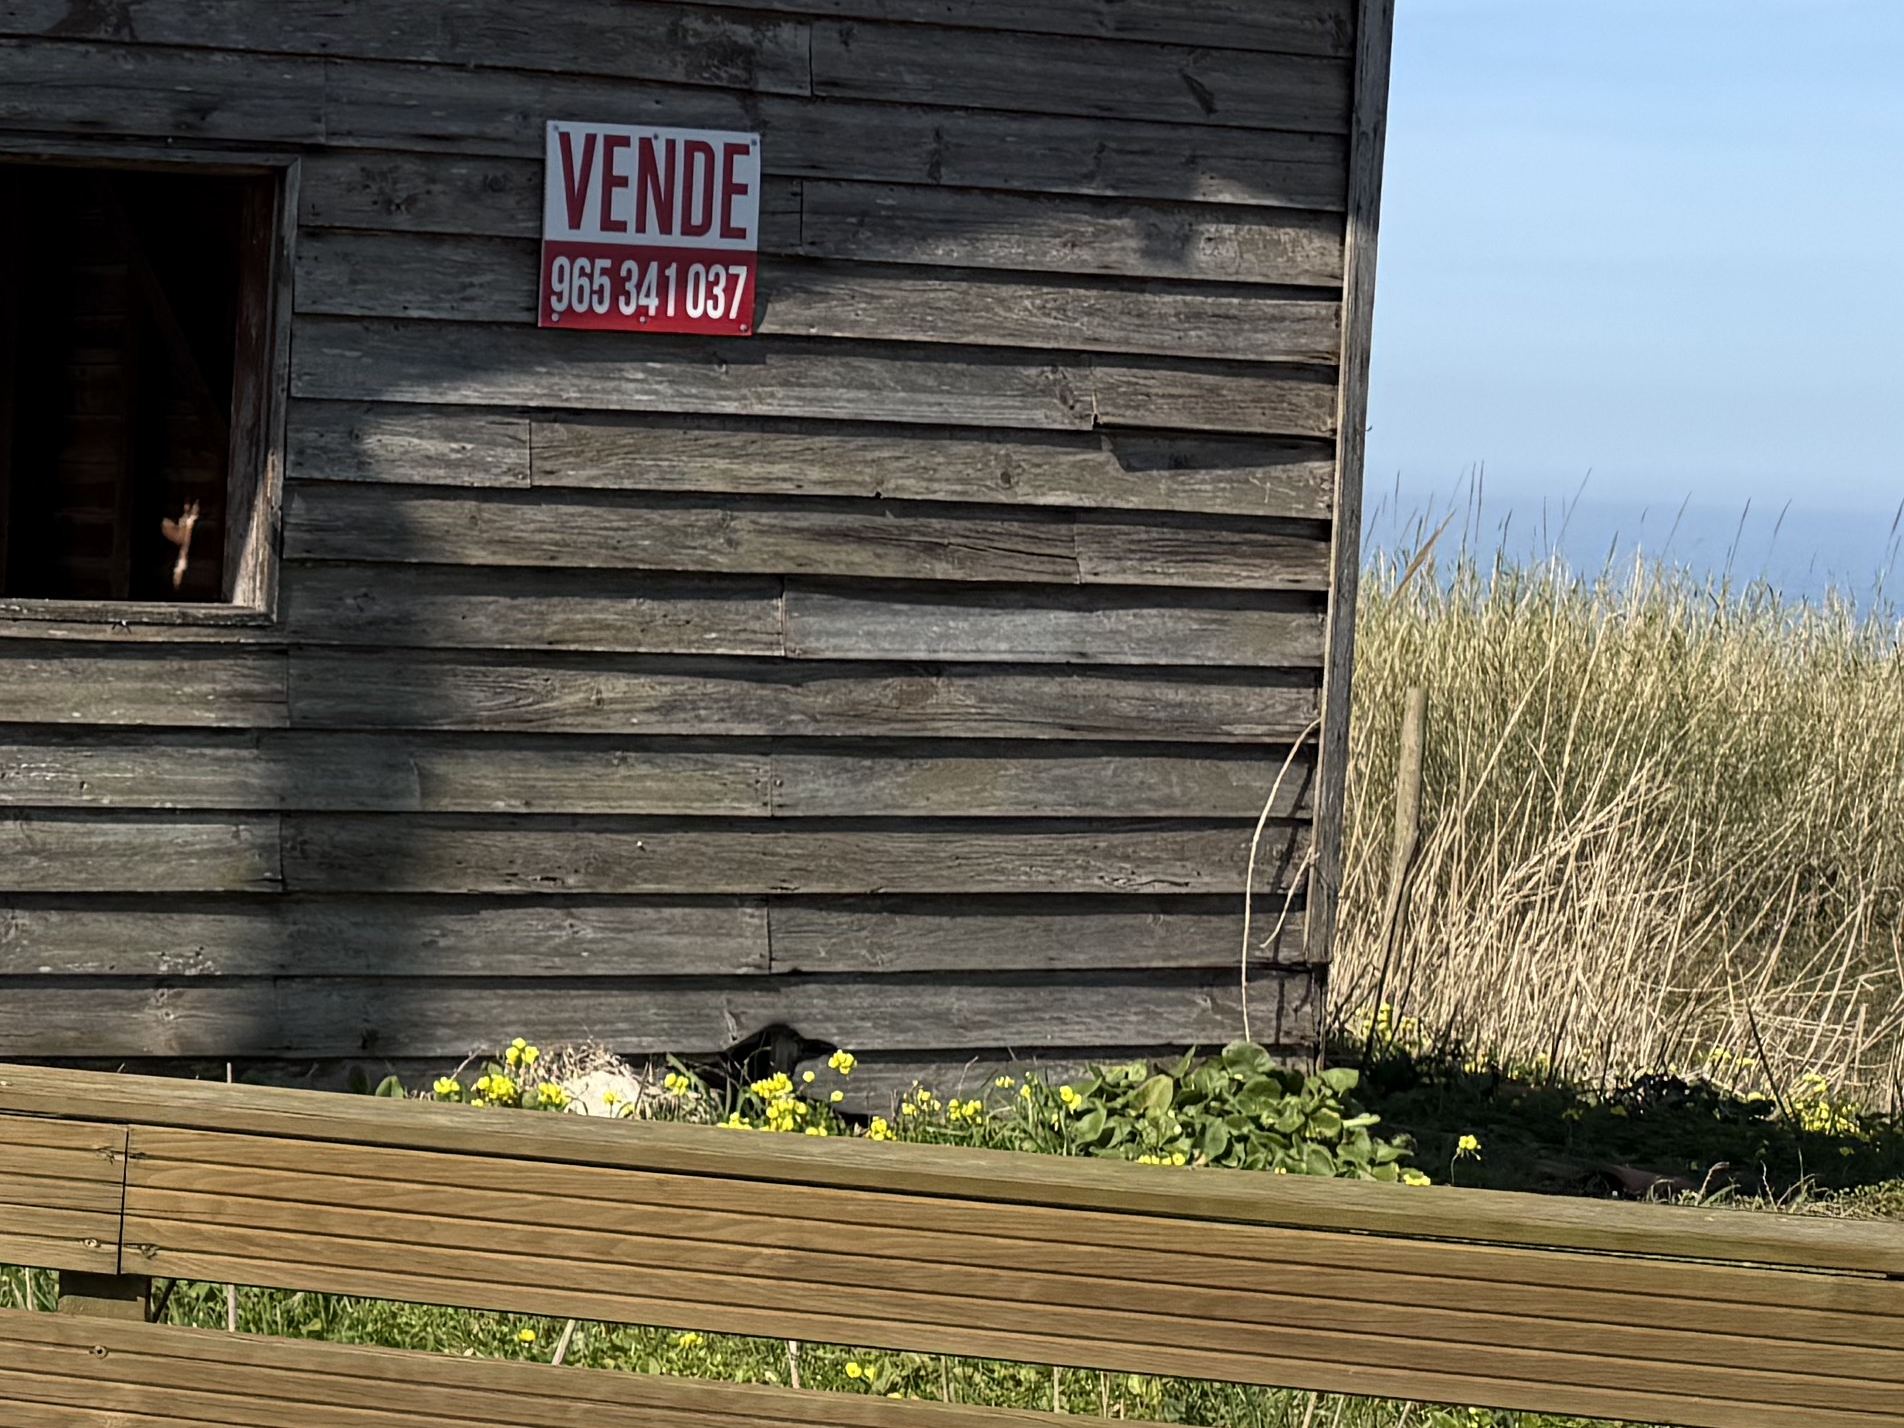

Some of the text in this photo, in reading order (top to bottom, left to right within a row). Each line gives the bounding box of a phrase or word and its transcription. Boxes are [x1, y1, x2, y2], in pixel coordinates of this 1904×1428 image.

[558, 131, 751, 241] VENDE
[550, 255, 748, 320] 965 341 037
